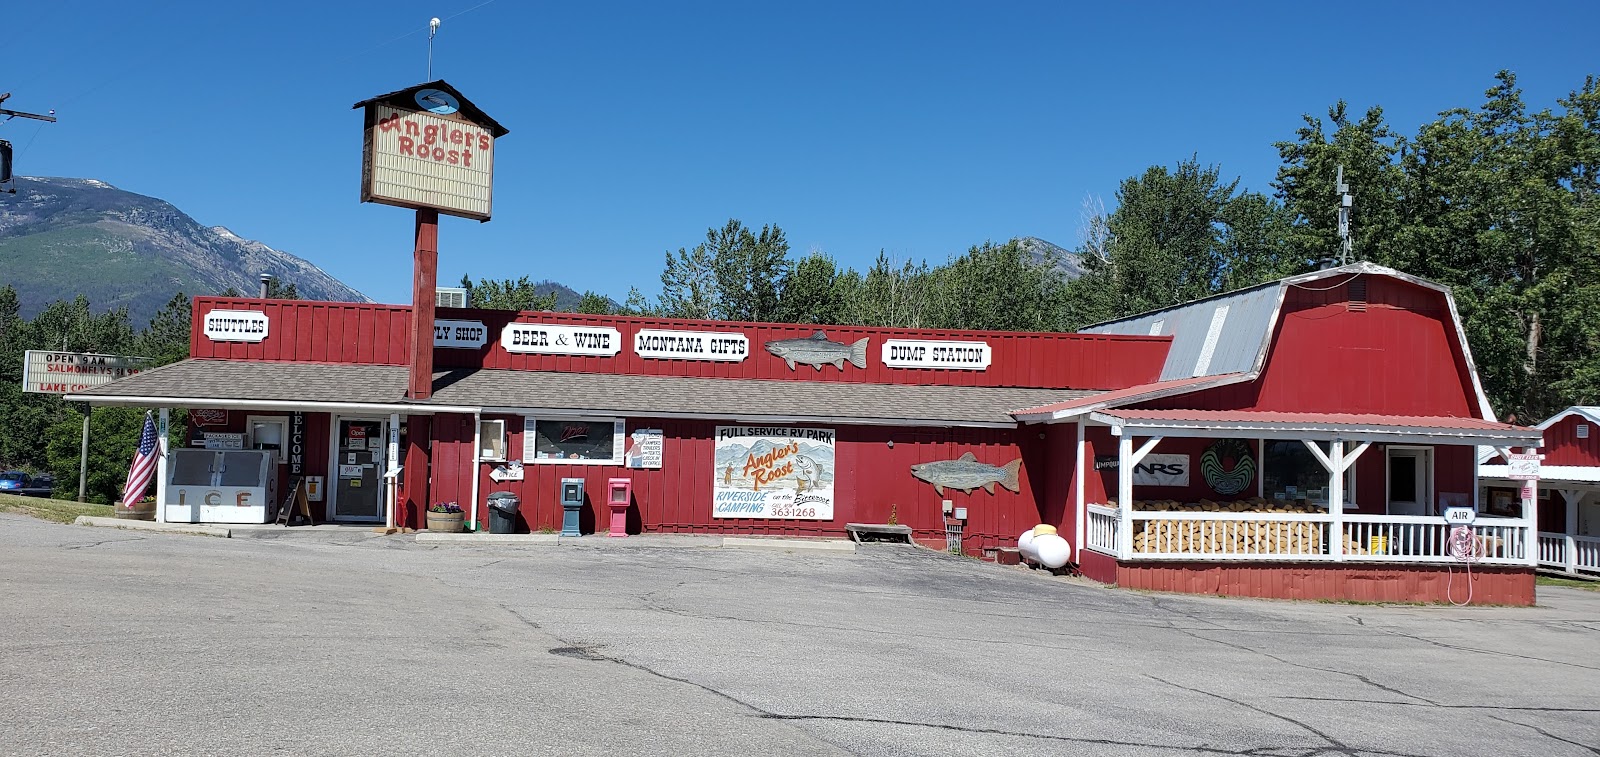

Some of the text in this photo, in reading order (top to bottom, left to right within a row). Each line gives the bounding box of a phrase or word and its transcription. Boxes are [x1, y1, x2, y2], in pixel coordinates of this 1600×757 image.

[379, 113, 489, 150] Angler's
[399, 135, 472, 167] Roost
[208, 318, 264, 333] SHUTTLES
[455, 327, 483, 341] SHOP
[513, 329, 610, 349] BEER & WINE
[638, 335, 745, 355] MONTANA GIFTS
[46, 354, 106, 365] OPEN 9 AM
[890, 345, 983, 363] DUMP STATION
[40, 383, 66, 392] LAKE
[350, 429, 366, 437] Open
[720, 428, 746, 442] FULL
[747, 428, 787, 437] SERVICE
[806, 429, 834, 446] PARK
[750, 460, 794, 492] Roost
[1134, 463, 1184, 475] NRS
[178, 489, 253, 508] ICE
[716, 491, 769, 502] RIVERSIDE
[717, 502, 766, 513] CAMPING
[1451, 511, 1468, 520] AIR
